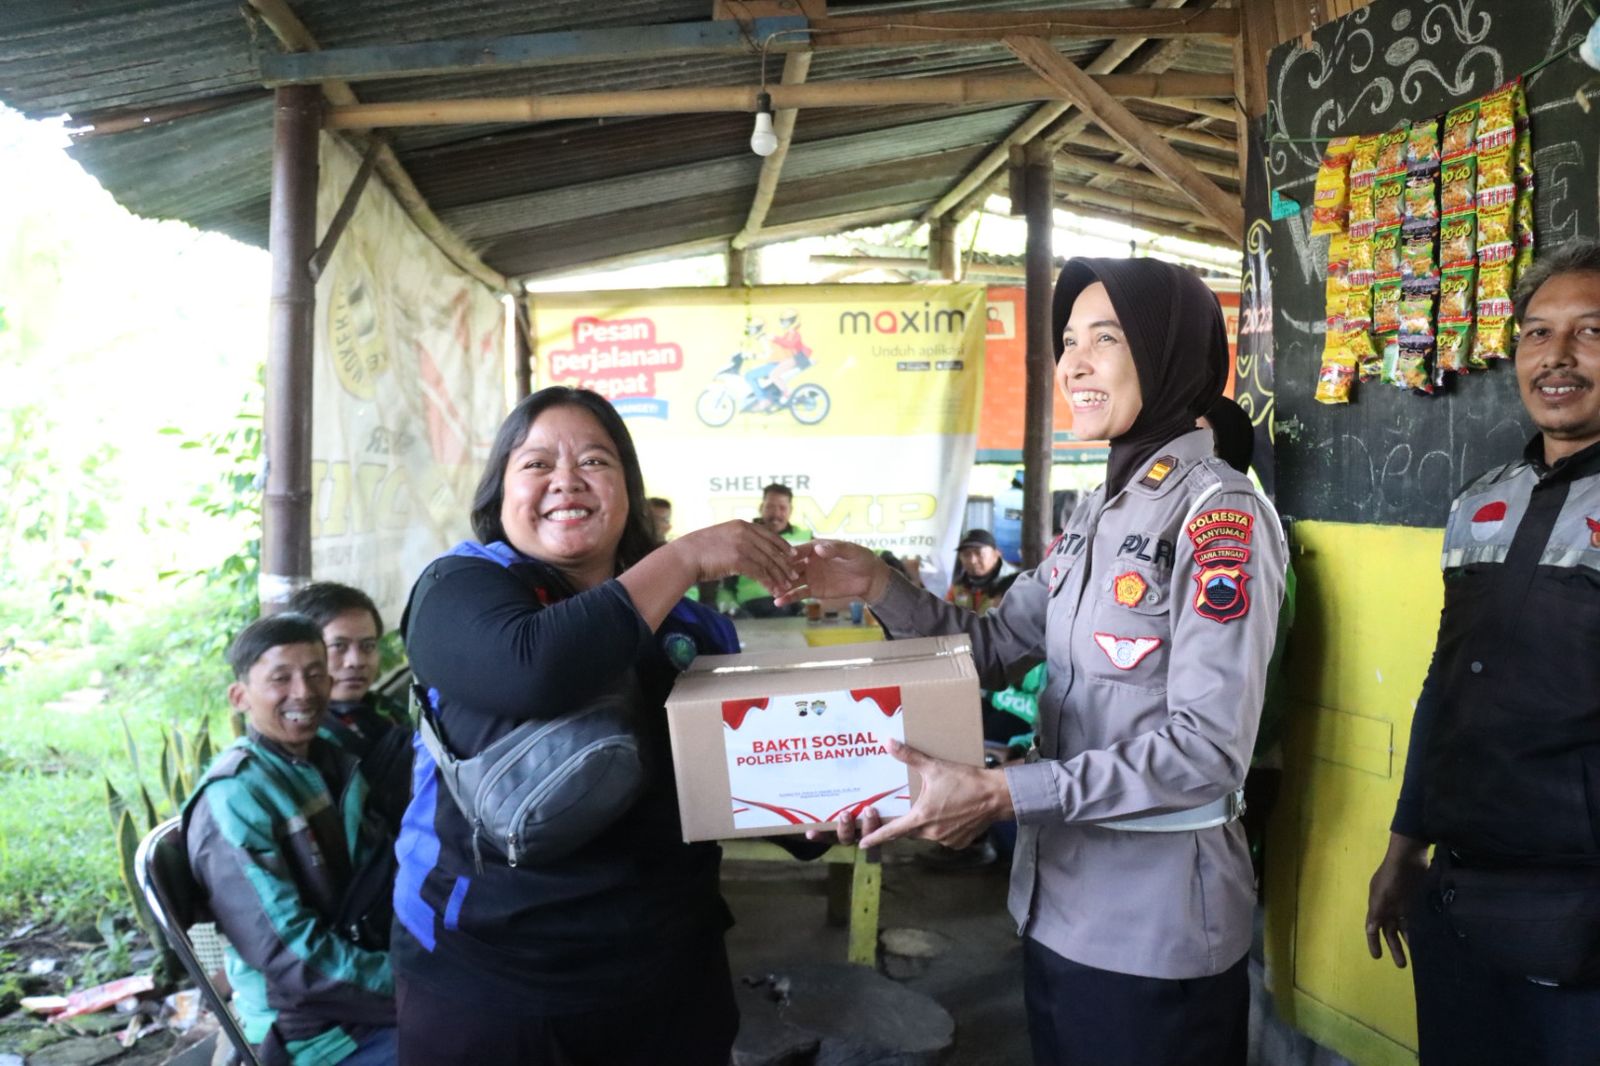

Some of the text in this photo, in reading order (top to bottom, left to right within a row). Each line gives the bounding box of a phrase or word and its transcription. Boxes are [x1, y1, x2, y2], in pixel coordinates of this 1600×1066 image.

[839, 302, 965, 334] maxim
[576, 322, 649, 344] Pesan
[552, 345, 677, 375] perjalanan
[872, 344, 915, 357] Unduh
[709, 474, 811, 492] SHELTER
[1189, 511, 1249, 533] POLRESTA
[1195, 527, 1246, 545] BANYUMAS
[1199, 550, 1245, 562] JAWA TENGAH
[752, 731, 879, 754] BAKTI SOSIAL
[736, 745, 888, 767] POLRESTA BANYUMA
